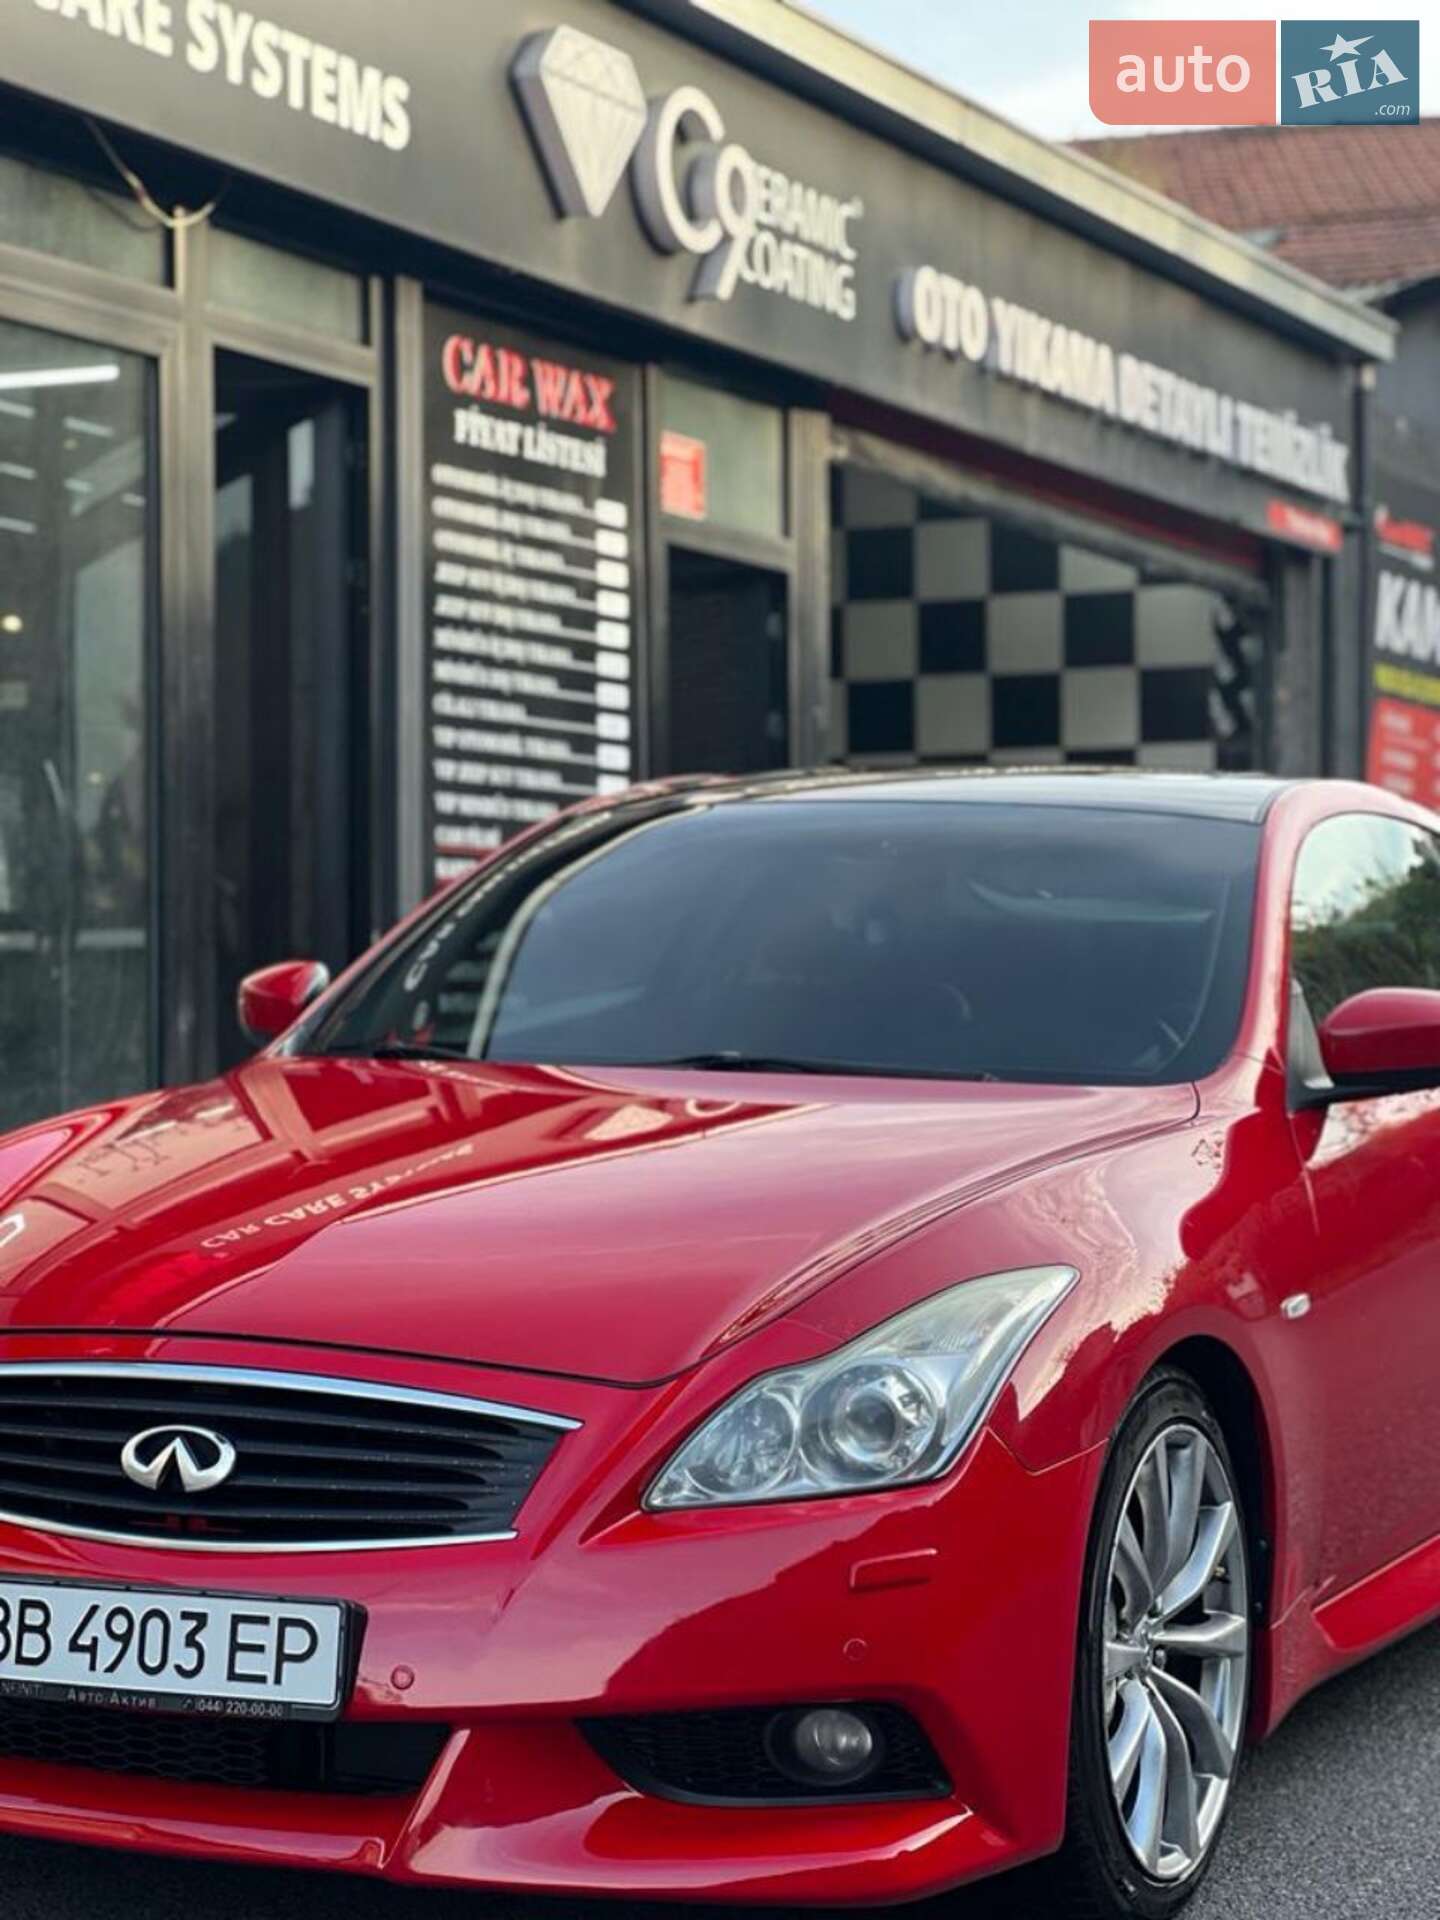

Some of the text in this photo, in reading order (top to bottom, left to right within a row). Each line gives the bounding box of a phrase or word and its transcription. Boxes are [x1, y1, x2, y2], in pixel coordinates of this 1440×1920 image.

[34, 0, 411, 150] RE SYSTEMS
[914, 265, 988, 362] OTO
[442, 334, 616, 434] CAR WAX
[68, 1604, 209, 1680] 4903
[226, 1613, 319, 1686] EP
